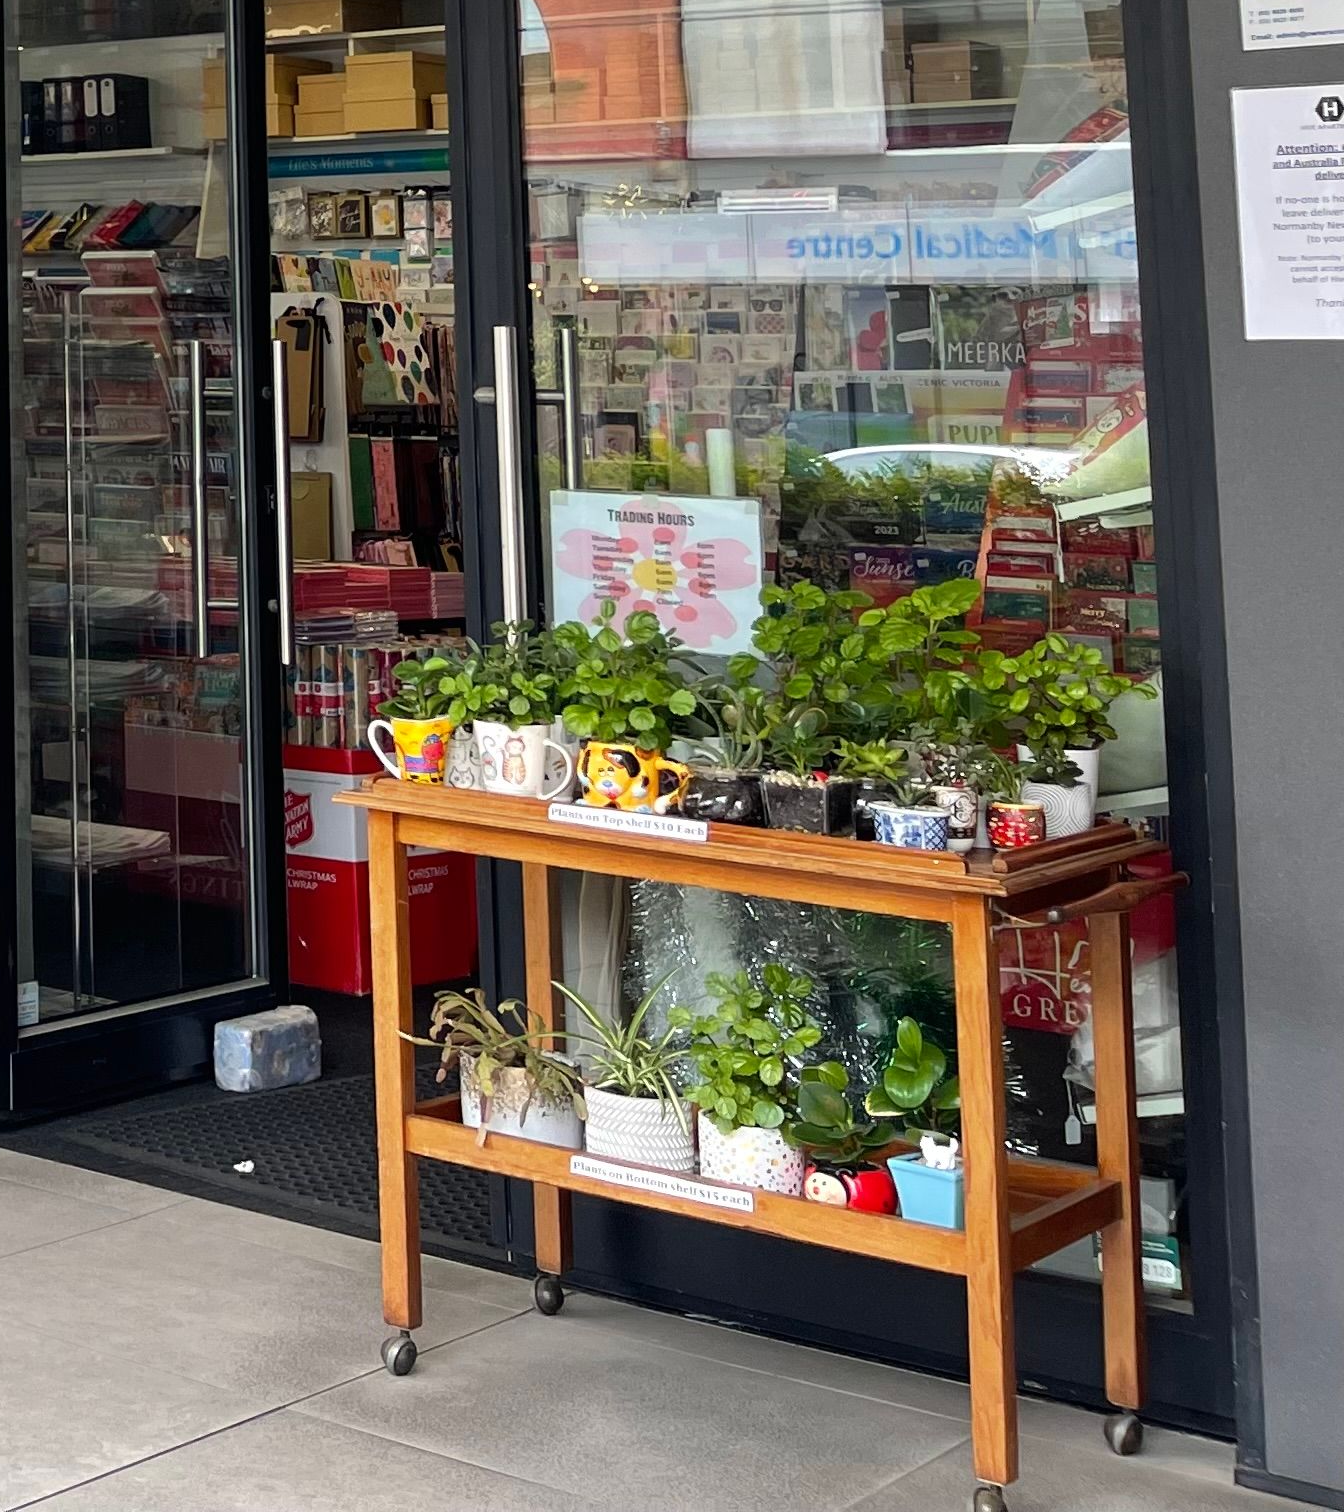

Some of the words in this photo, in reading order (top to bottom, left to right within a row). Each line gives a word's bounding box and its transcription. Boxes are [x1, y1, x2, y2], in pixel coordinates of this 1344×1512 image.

[1277, 143, 1340, 155] Attention:
[1273, 159, 1292, 168] and
[1294, 157, 1339, 168] Australia
[1285, 195, 1320, 205] no-one
[1282, 208, 1308, 218] leave
[1273, 222, 1324, 234] Normanby
[947, 341, 1028, 364] MEERKA
[952, 378, 1001, 388] VICTORIA
[607, 509, 654, 525] TRADING
[657, 511, 695, 527] HOURS
[286, 816, 309, 839] ARMY
[551, 808, 584, 820] Plants
[585, 814, 600, 822] on
[602, 814, 624, 827] Top
[625, 818, 651, 830] shelf
[676, 824, 705, 836] Each
[287, 868, 337, 883] CHRISTMAS
[408, 865, 449, 881] CHRISTMAS
[1013, 993, 1091, 1026] GRE
[573, 1161, 607, 1175] Plants
[608, 1170, 623, 1180] on
[626, 1172, 667, 1188] Bottom
[670, 1182, 697, 1196] shelf
[722, 1194, 750, 1206] each
